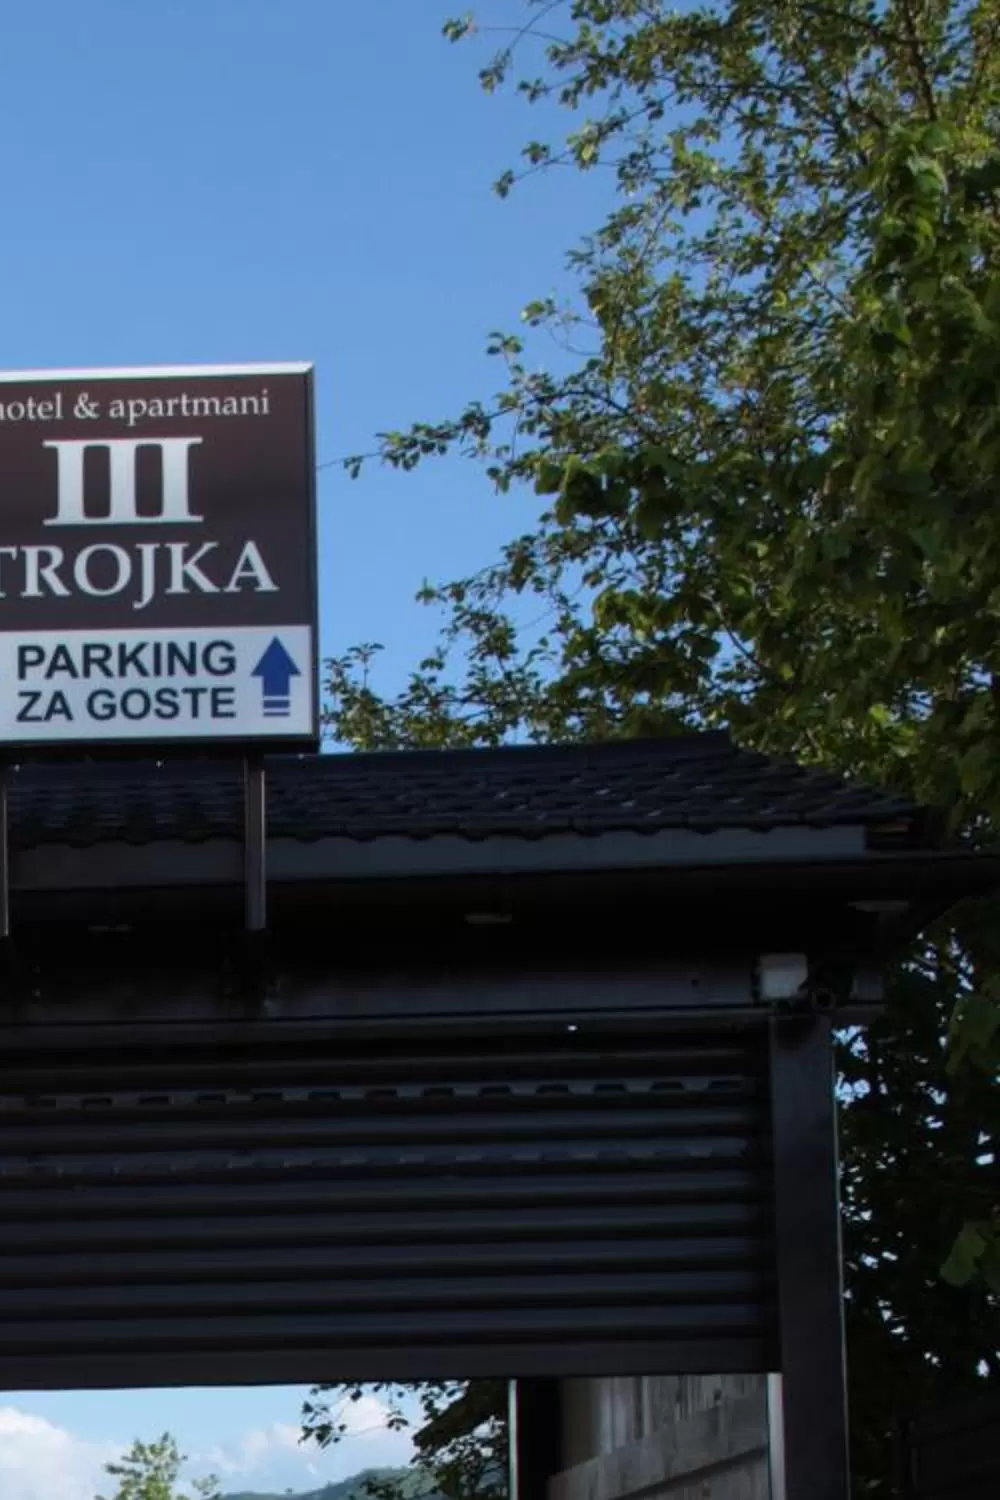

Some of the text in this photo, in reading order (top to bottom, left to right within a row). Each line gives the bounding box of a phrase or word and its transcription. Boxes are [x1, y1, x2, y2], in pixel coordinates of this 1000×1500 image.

[73, 392, 99, 419] &
[109, 389, 270, 426] apartmani
[42, 436, 203, 526] III
[17, 640, 236, 680] PARKING
[16, 687, 236, 723] ZA GOSTE
